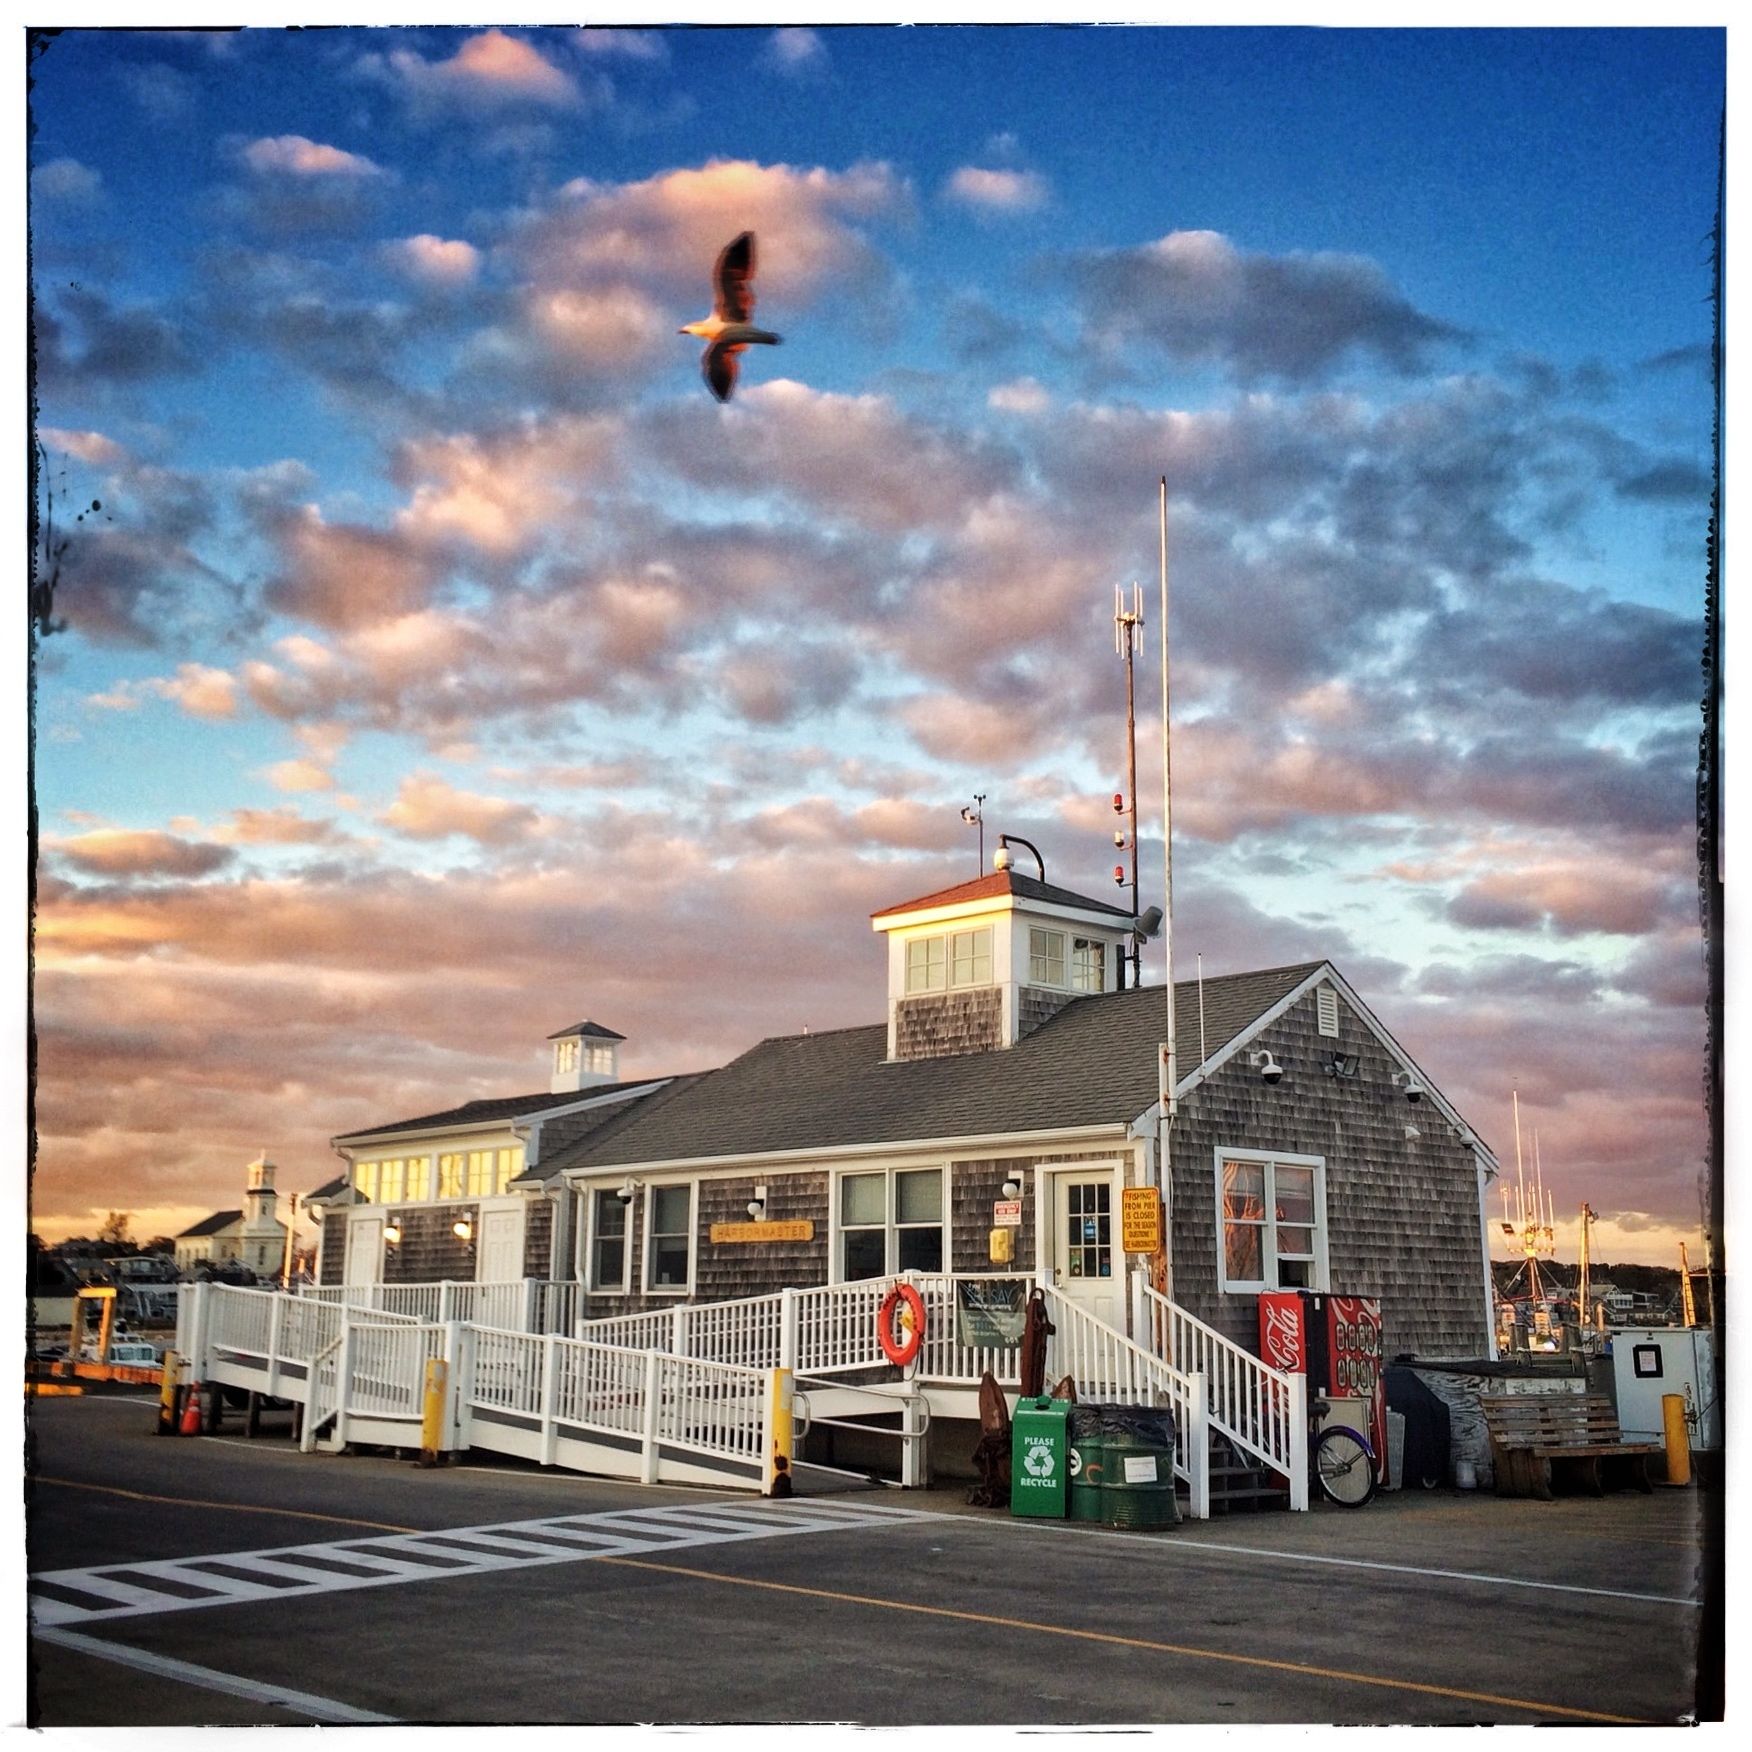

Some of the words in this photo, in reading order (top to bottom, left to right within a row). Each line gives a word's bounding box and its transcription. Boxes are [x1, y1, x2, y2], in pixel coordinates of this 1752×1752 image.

[1125, 1202, 1142, 1210] FROM
[1144, 1202, 1156, 1210] PIER
[1126, 1211, 1131, 1219] IS
[1133, 1211, 1155, 1219] CLOSED
[717, 1225, 806, 1240] HARBORMASTER
[1265, 1299, 1300, 1370] Cola
[1024, 1436, 1055, 1446] PLEASE
[1020, 1477, 1057, 1488] RECYCLE
